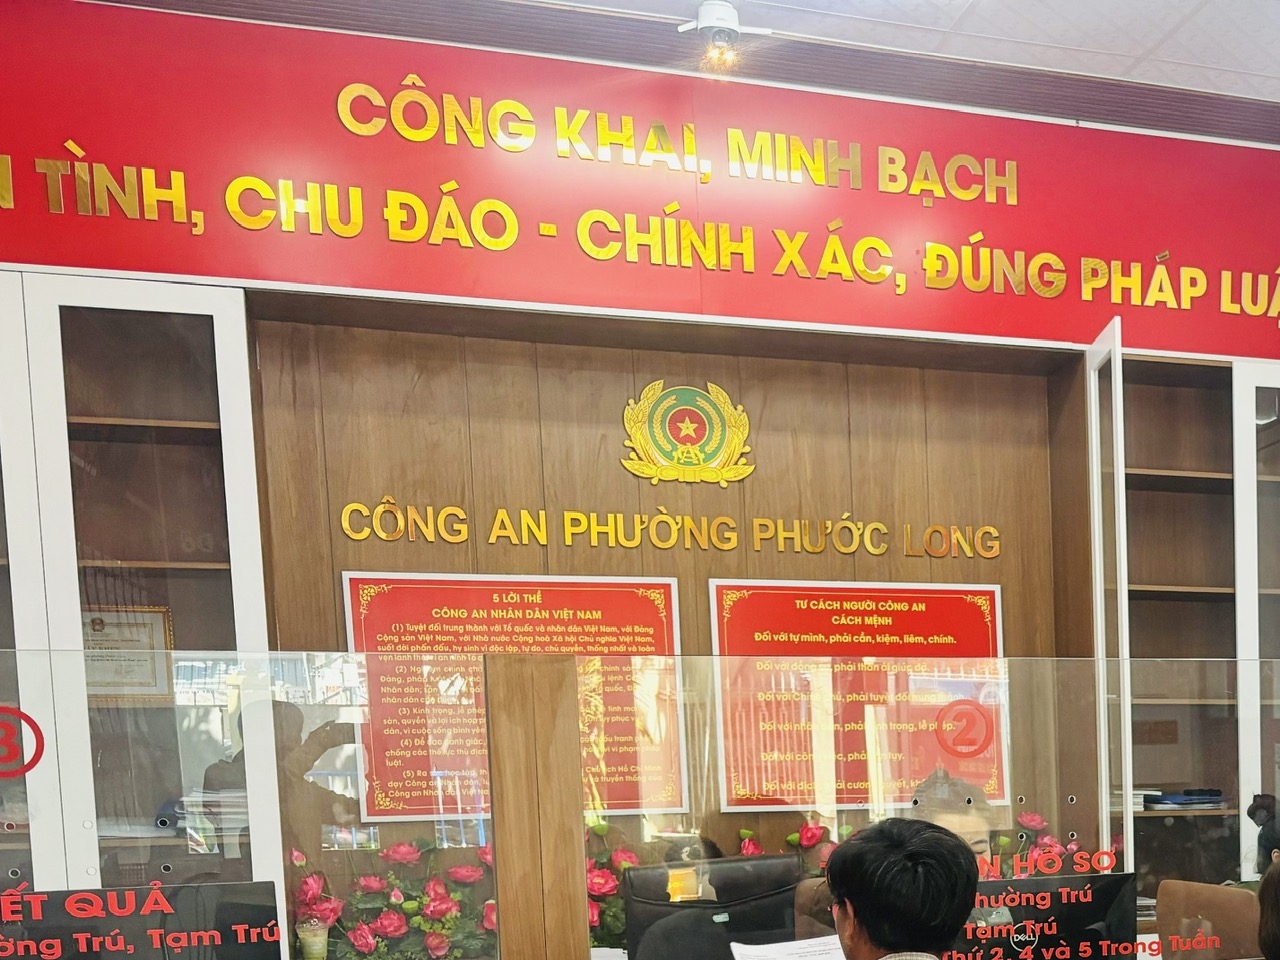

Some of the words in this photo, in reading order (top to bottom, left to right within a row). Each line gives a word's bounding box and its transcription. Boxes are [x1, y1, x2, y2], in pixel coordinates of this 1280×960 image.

[337, 74, 536, 152] CÔNG
[556, 107, 711, 181] KHAI,
[727, 128, 862, 190] MINH
[878, 146, 1018, 207] BẠCH
[35, 139, 204, 235] TÌNH,
[225, 176, 363, 237] CHU
[384, 180, 518, 250] ĐÁO
[577, 201, 755, 274] CHÍNH
[773, 217, 907, 295] XÁC,
[922, 231, 1065, 298] ĐÚNG
[1080, 250, 1207, 310] PHÁP
[340, 496, 468, 543] CÔNG
[489, 509, 547, 546] AN
[564, 505, 738, 551] PHƯỜNG
[753, 512, 888, 555] PHƯỚC
[905, 523, 1001, 559] LONG
[493, 594, 499, 603] 5
[502, 592, 520, 603] LỜI
[523, 590, 542, 604] THỀ
[795, 600, 808, 610] TƯ
[810, 598, 840, 610] CÁCH
[843, 599, 876, 611] NGƯỜI
[878, 601, 908, 612] CÔNG
[912, 603, 926, 612] AN
[432, 607, 468, 619] CÔNG
[472, 609, 488, 619] AN
[491, 608, 522, 619] NHÂN
[526, 608, 549, 619] DÂN
[552, 608, 574, 622] VIỆT
[577, 610, 602, 620] NAM
[832, 614, 861, 625] CÁCH
[864, 615, 892, 628] MỆNH
[392, 624, 403, 633] (1)
[406, 623, 426, 634] Tuyệt
[429, 623, 441, 632] đối
[443, 624, 464, 635] trung
[466, 623, 488, 632] thành
[490, 623, 501, 632] với
[503, 622, 512, 632] Tổ
[514, 623, 533, 635] quốc
[535, 624, 545, 633] và
[547, 624, 565, 633] nhân
[568, 624, 582, 633] dân
[584, 623, 598, 635] Việt
[601, 625, 619, 635] Nam,
[622, 624, 632, 633] với
[634, 624, 654, 636] Đảng
[754, 631, 772, 641] Đối
[774, 632, 788, 642] với
[790, 632, 801, 644] tự
[801, 633, 827, 644] mình,
[830, 633, 851, 645] phải
[853, 632, 874, 644] cần,
[876, 633, 902, 645] kiệm,
[904, 634, 926, 645] liêm,
[929, 633, 957, 644] chính.
[952, 712, 978, 746] 2
[979, 854, 1000, 876] N
[1013, 844, 1062, 874] HỒ
[1073, 848, 1117, 873] SƠ
[0, 881, 48, 922] ẾT
[64, 881, 174, 918] QUẢ
[975, 886, 1050, 910] hường
[1058, 884, 1092, 904] Trú
[0, 930, 61, 960] ờng
[73, 929, 134, 954] Trú,
[147, 928, 220, 952] Tạm
[232, 920, 280, 943] Trú
[963, 922, 1014, 944] Tạm
[1026, 916, 1057, 936] Trú
[1013, 932, 1036, 942] DELL
[1019, 946, 1034, 960] 4
[1041, 940, 1070, 960] và
[1079, 942, 1092, 958] 5
[1099, 939, 1162, 957] Trong
